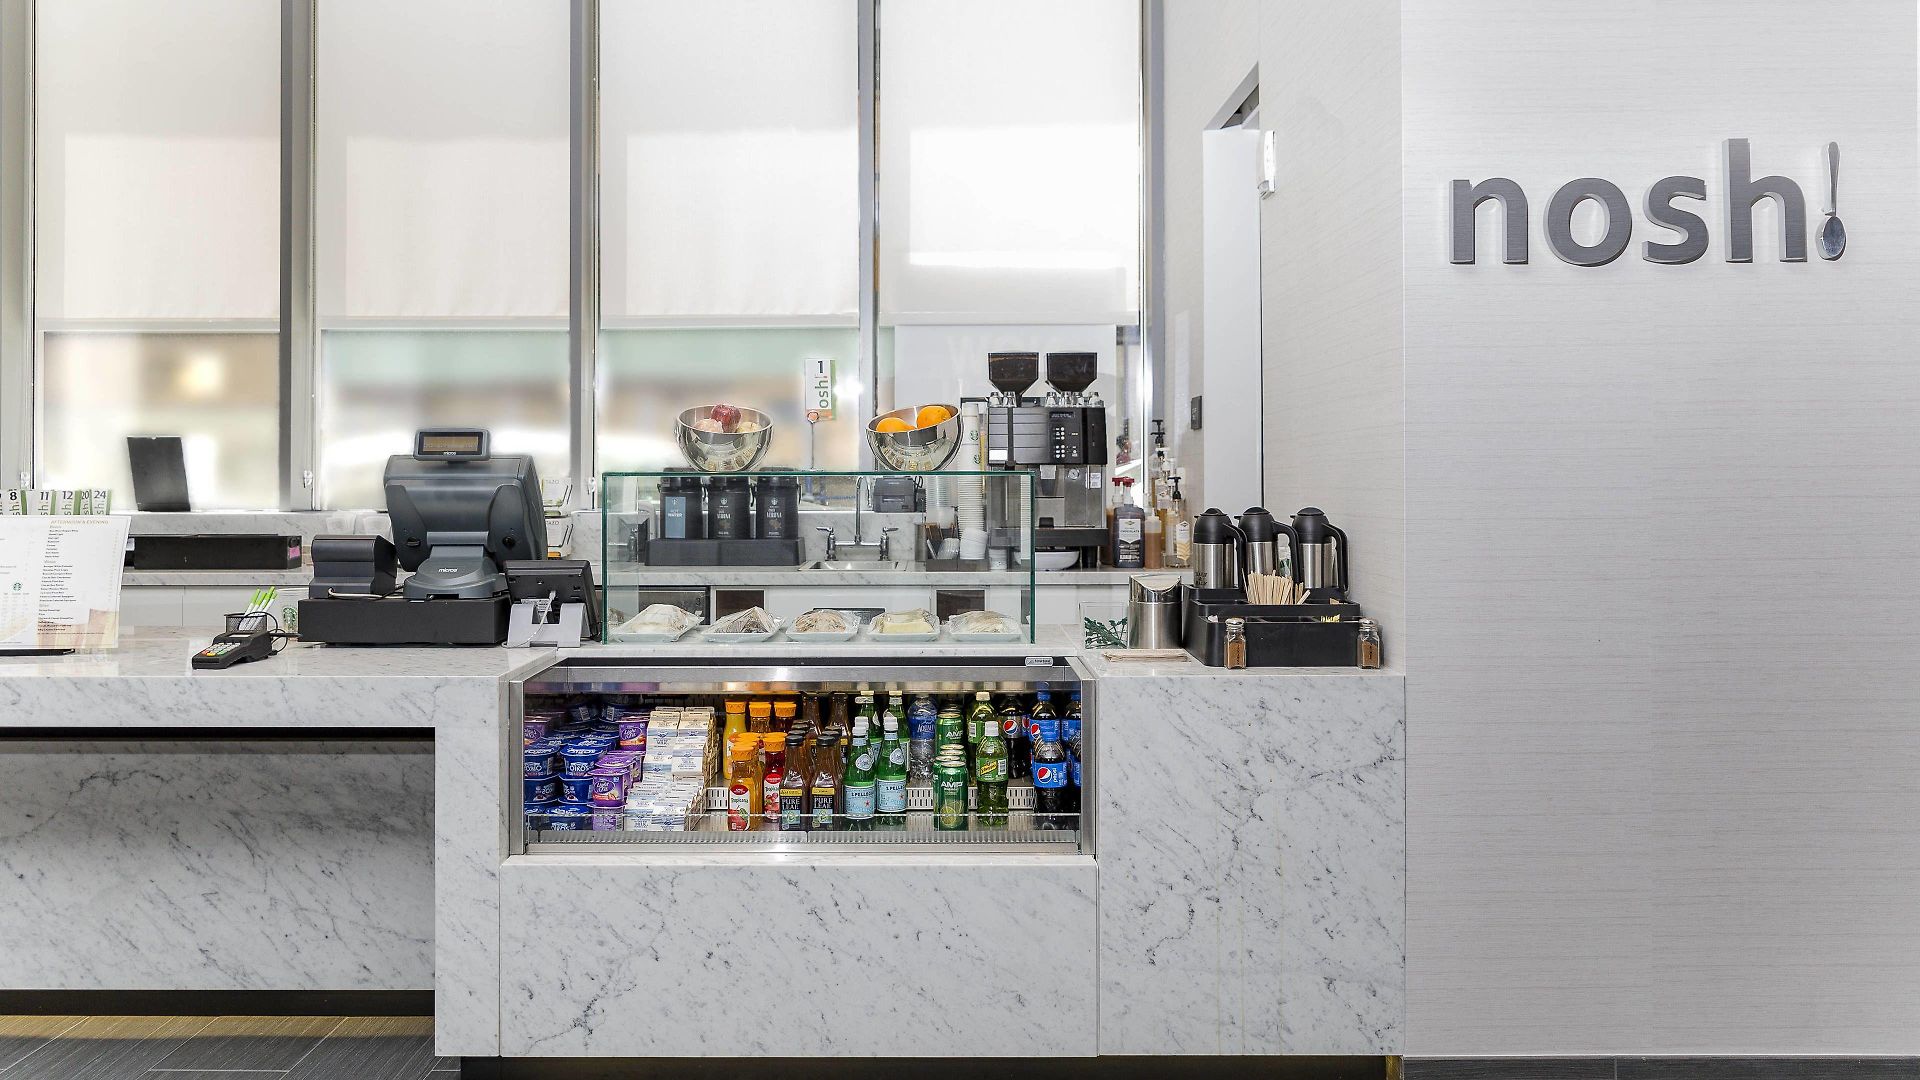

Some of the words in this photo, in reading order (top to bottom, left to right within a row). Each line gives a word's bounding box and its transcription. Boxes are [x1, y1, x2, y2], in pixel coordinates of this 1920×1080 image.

[817, 360, 824, 374] 1
[815, 375, 829, 408] osh!
[9, 491, 18, 501] 8
[40, 491, 49, 500] 11
[62, 490, 73, 500] 12
[81, 490, 89, 499] 20
[94, 490, 106, 499] 24
